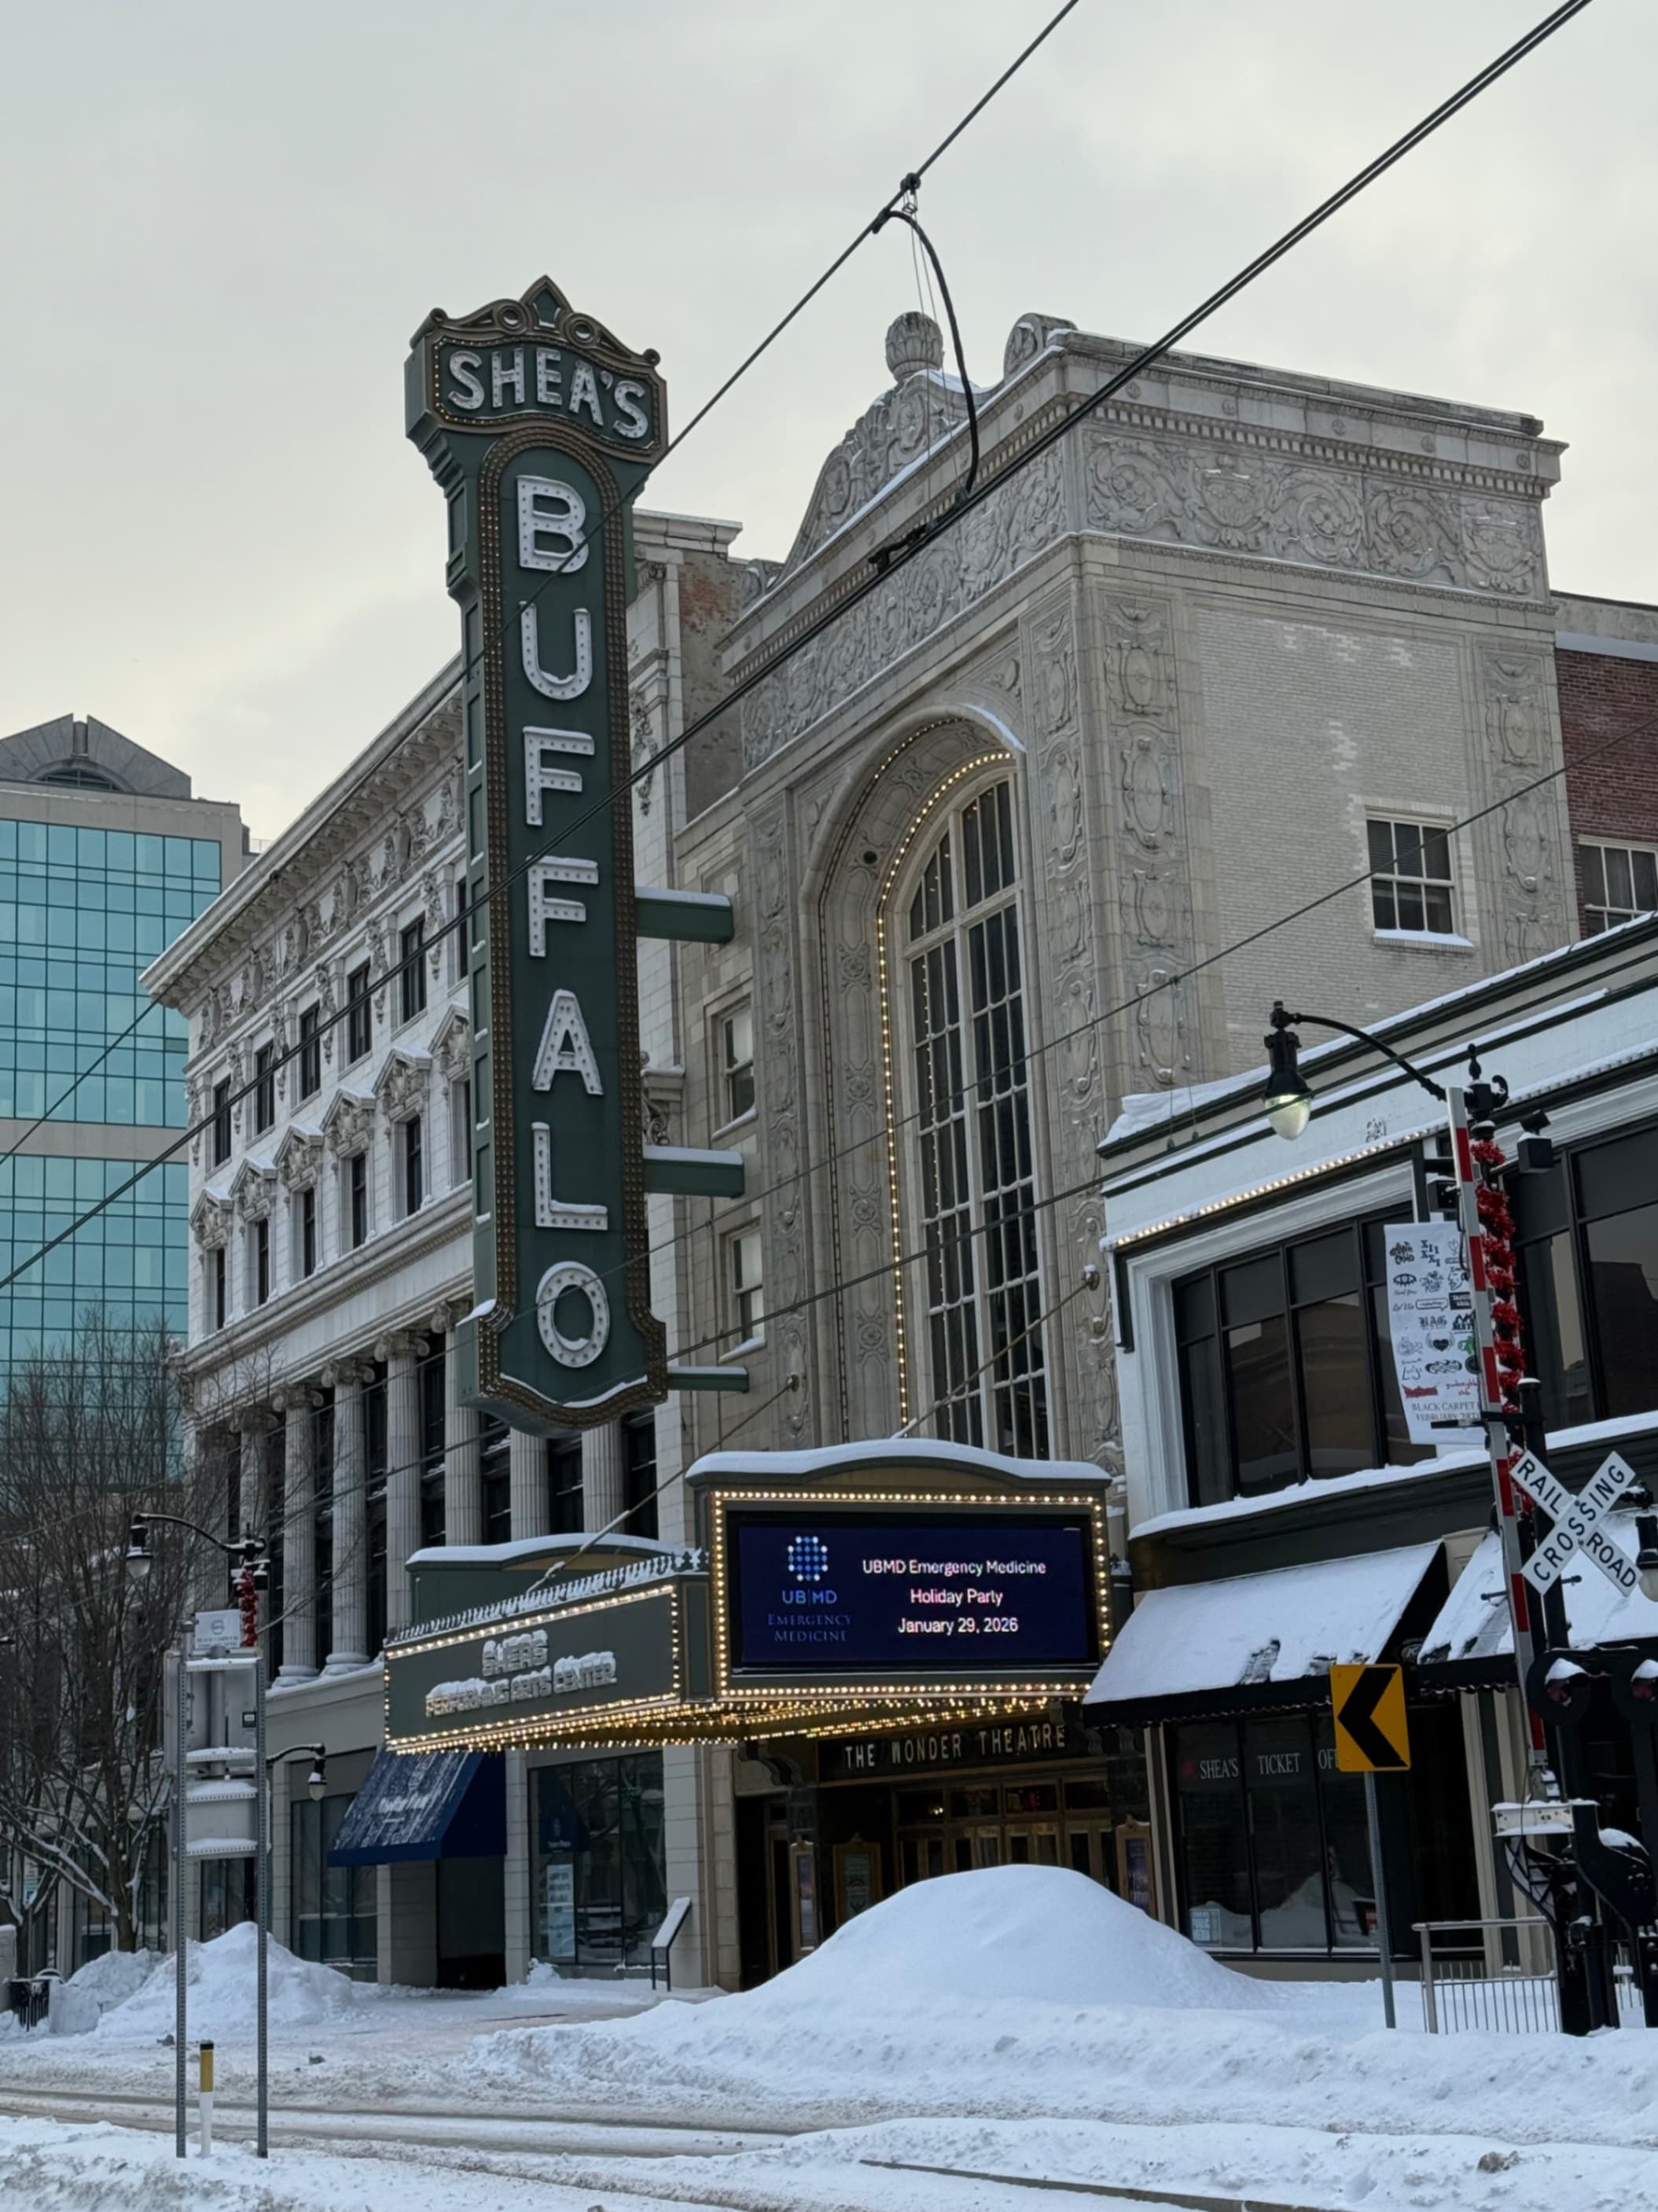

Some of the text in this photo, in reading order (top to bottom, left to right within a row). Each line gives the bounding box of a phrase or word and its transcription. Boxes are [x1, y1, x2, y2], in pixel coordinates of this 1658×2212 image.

[447, 346, 649, 440] SHEA'S
[517, 474, 611, 1368] BUFFALO
[1412, 1403, 1440, 1411] BLACK
[1442, 1401, 1474, 1411] CARPET
[1517, 1459, 1636, 1588] RAIL ROAD
[1534, 1465, 1625, 1581] CROSSING
[862, 1559, 1046, 1577] UBMD Emergency Medicine
[910, 1588, 1003, 1607] Holiday Party
[767, 1614, 852, 1626] EMERGENCY
[898, 1618, 1020, 1635] January 29, 2026
[774, 1630, 847, 1643] MEDICINE
[844, 1724, 1065, 1768] THE WONDER THEATRE
[1199, 1758, 1239, 1780] SHEA'S
[1257, 1753, 1301, 1775] TICKET
